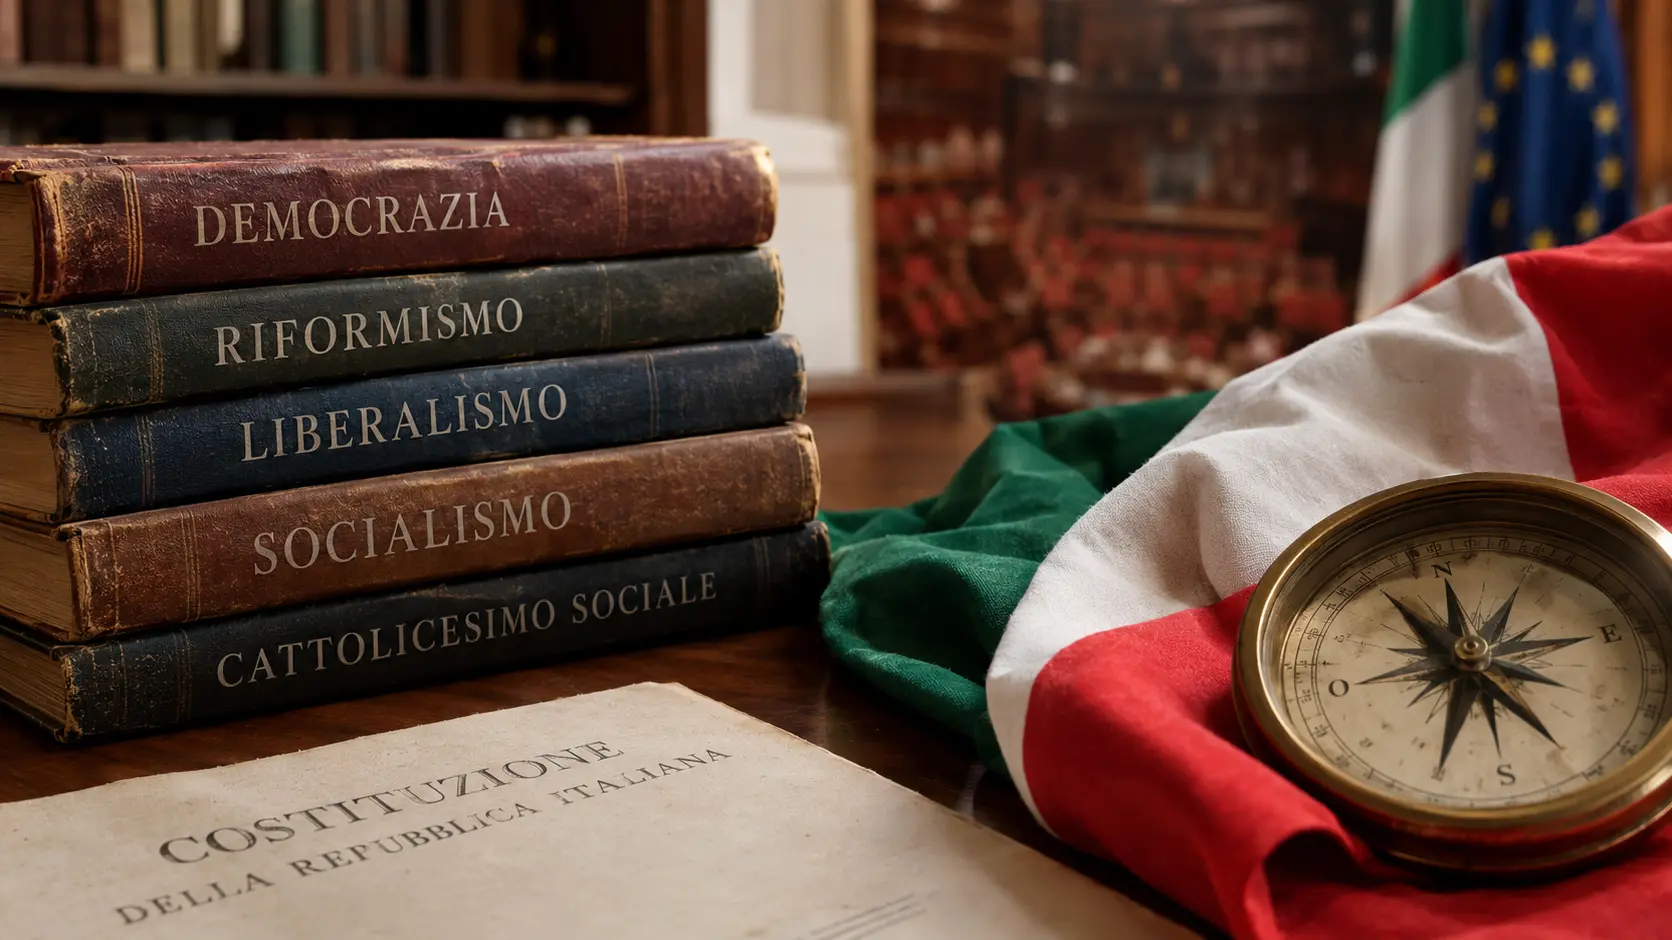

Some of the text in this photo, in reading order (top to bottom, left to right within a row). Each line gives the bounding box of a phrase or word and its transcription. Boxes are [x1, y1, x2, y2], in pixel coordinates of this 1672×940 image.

[194, 191, 509, 247] DEMOCRAZIA
[215, 298, 523, 366] RIFORMISMO
[241, 384, 567, 461] LIBERALISMO
[253, 491, 572, 576] SOCIALISMO
[1431, 561, 1453, 579] N
[217, 572, 717, 688] CATTOLICESIMO SOCIALE
[1601, 624, 1623, 644] E
[1328, 678, 1350, 698] O
[158, 740, 625, 865] COSTITUZIONE
[1496, 763, 1517, 786] S
[115, 747, 733, 926] DELLA REPUBBLICA ITALIANA
